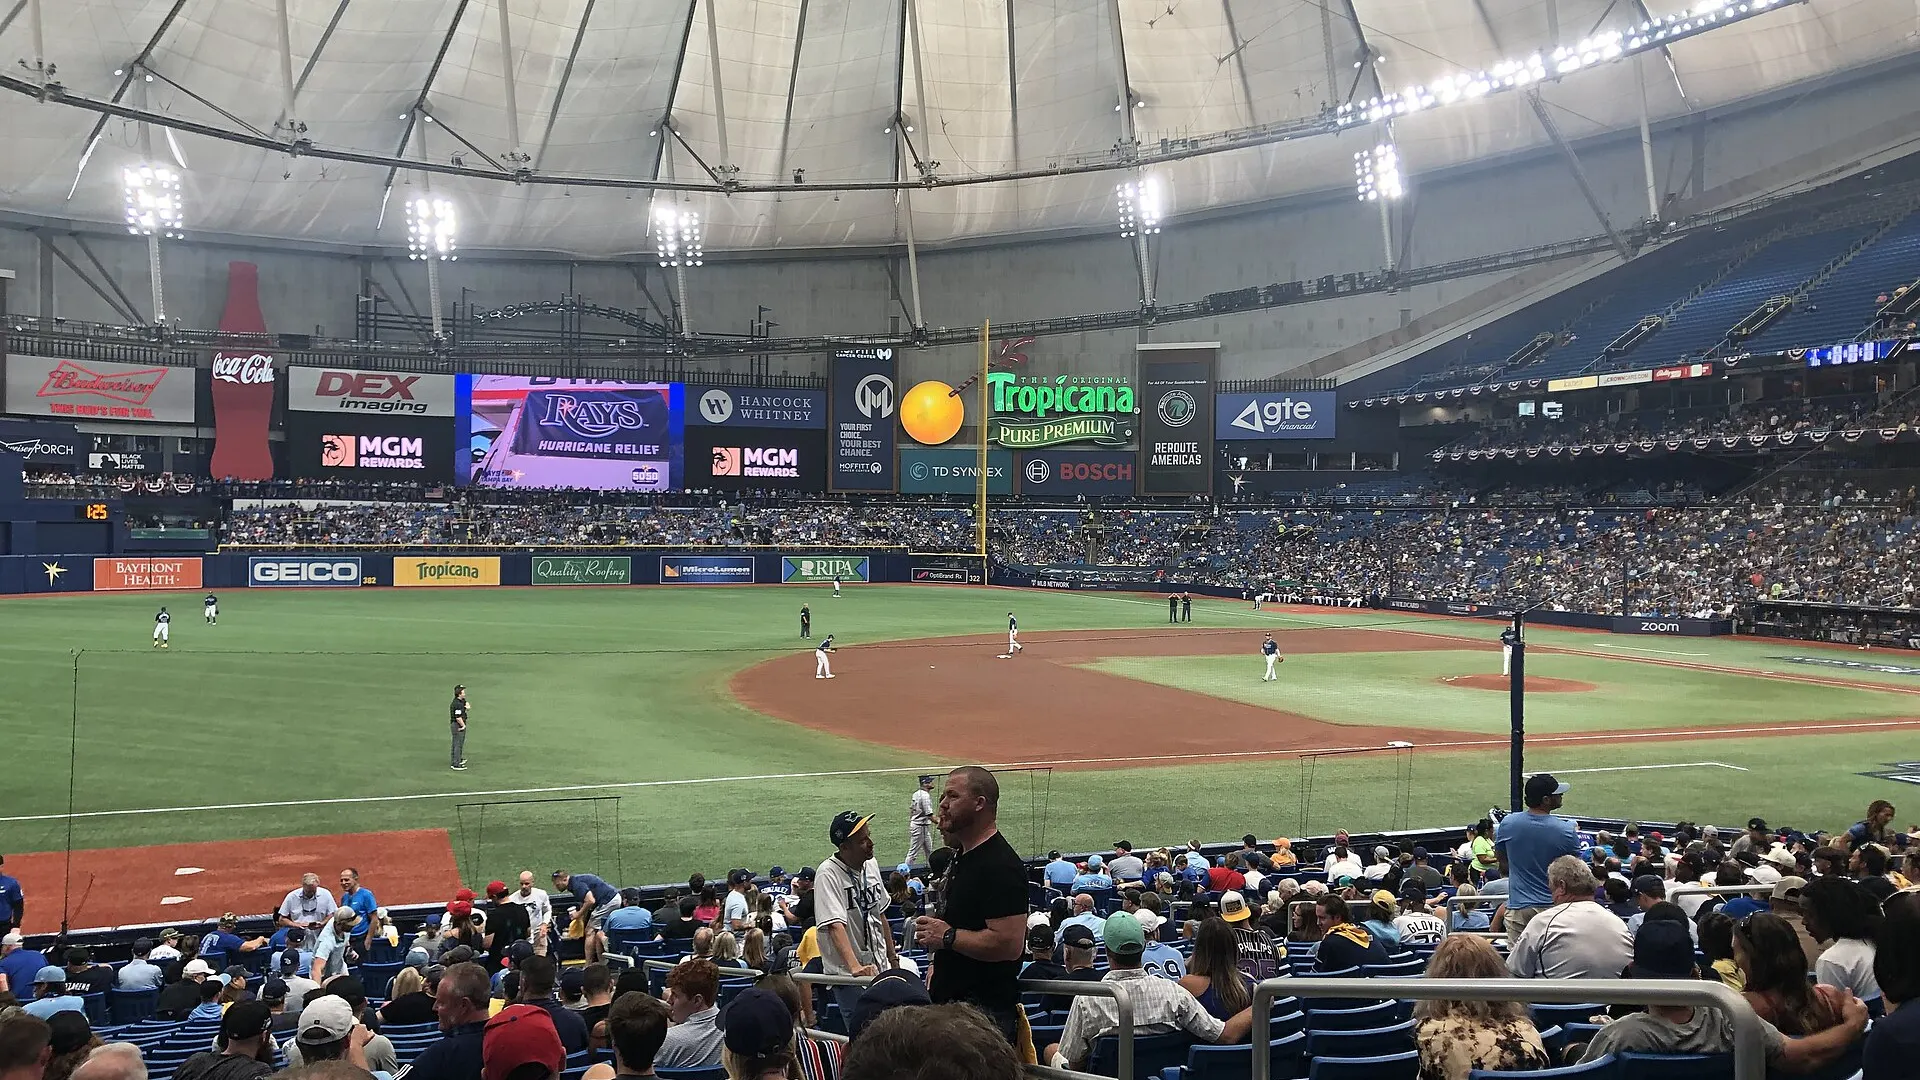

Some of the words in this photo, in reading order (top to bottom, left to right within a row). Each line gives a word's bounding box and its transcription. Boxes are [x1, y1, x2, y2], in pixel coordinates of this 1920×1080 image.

[212, 351, 274, 384] Coca-Cola
[49, 370, 155, 393] Budweiser
[315, 371, 421, 400] DEX
[1020, 376, 1048, 384] THE
[1072, 376, 1128, 384] ORIGINAL
[740, 396, 812, 408] HANCOCK
[986, 372, 1134, 417] Tropicana
[50, 403, 74, 414] THIS
[76, 405, 108, 416] BUD'S
[110, 406, 130, 417] FOR
[339, 397, 428, 413] imaging
[1264, 398, 1312, 426] gte
[539, 393, 643, 438] RAYS
[740, 408, 811, 421] WHITNEY
[840, 423, 856, 431] YOUR
[856, 423, 872, 431] FIRST
[1000, 426, 1040, 443] PURE
[1043, 420, 1115, 440] PREMIUM
[1272, 420, 1317, 434] financial
[35, 444, 73, 455] PORCH
[359, 435, 423, 456] MGM
[538, 440, 611, 454] HURRICANE
[614, 444, 660, 455] RELIEF
[840, 440, 862, 448] YOUR
[862, 440, 882, 448] BEST
[1155, 442, 1198, 454] REROUTE
[744, 448, 798, 466] MGM
[1151, 454, 1202, 466] AMERICAS
[932, 466, 949, 477] TD
[952, 466, 1003, 477] SYNNEX
[1060, 464, 1132, 480] BOSCH
[116, 562, 183, 574] BAYFRONT
[254, 562, 358, 581] GEICO
[416, 561, 479, 580] Tropicana
[538, 560, 580, 578] Quality
[584, 560, 626, 580] Roofing
[815, 560, 854, 576] RIPA
[362, 576, 377, 584] 382
[929, 572, 954, 580] OptiBrand
[1641, 622, 1680, 632] zoom
[760, 886, 788, 894] GONZALEZ
[1407, 920, 1444, 936] GLOVER
[1238, 942, 1272, 955] PHILLIPS
[1144, 960, 1182, 980] 69
